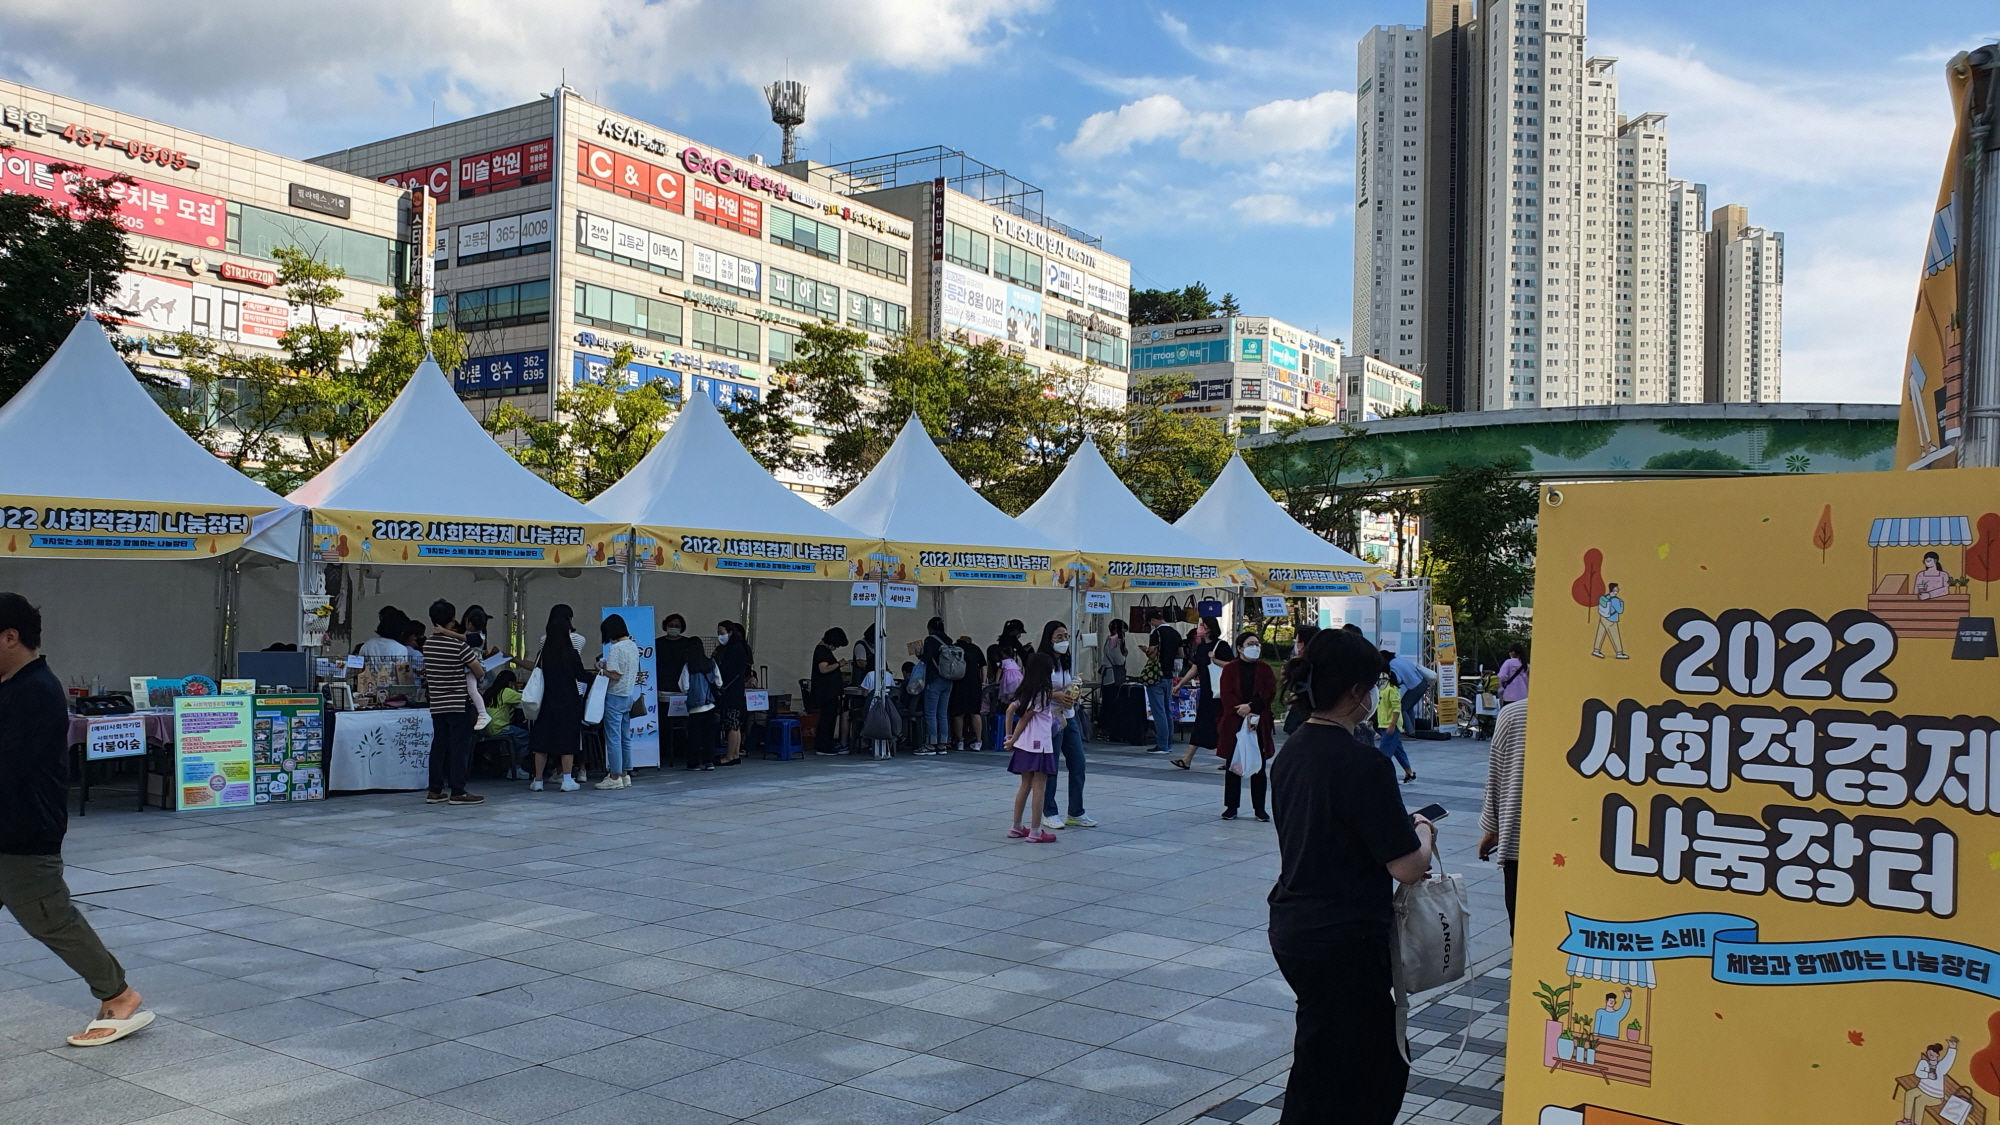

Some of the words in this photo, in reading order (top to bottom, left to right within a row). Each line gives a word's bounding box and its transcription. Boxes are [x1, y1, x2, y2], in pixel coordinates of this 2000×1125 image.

[0, 104, 47, 134] 학원
[62, 122, 187, 169] 437-0505
[462, 151, 521, 184] 미술학원
[590, 150, 613, 179] C
[656, 172, 678, 199] C
[737, 168, 789, 200] 미술학원
[177, 197, 217, 226] 모집
[695, 187, 739, 218] 미술학원
[463, 231, 489, 248] 고등관
[496, 219, 548, 244] 365-4009
[591, 225, 610, 242] 정상
[617, 232, 645, 252] 고등관
[224, 264, 275, 285] STRIKEZON
[1060, 270, 1082, 295] 패스
[775, 274, 834, 308] 피아노
[852, 296, 883, 323] 보컬
[945, 282, 966, 305] 등관
[968, 290, 984, 310] 8월
[986, 296, 1004, 316] 이전
[523, 354, 545, 367] 362-
[1152, 351, 1176, 361] ETOOS
[1189, 349, 1201, 358] 학원
[523, 367, 545, 381] 6395
[44, 508, 159, 534] 사회적경제
[164, 511, 249, 536] 나눔장터
[374, 521, 425, 542] 2022
[429, 522, 516, 545] 사회적경제
[519, 526, 585, 546] 나눔장터
[40, 537, 74, 547] 가치있는
[96, 539, 121, 548] 체험과
[123, 540, 156, 548] 함께하는
[157, 541, 188, 549] 나눔장터
[514, 550, 538, 558] 나눔장터
[682, 536, 722, 555] 2022
[725, 538, 794, 559] 사회적경제
[796, 543, 848, 561] 나눔장터
[921, 552, 954, 568] 2022
[955, 553, 1009, 569] 사회적경제
[1010, 555, 1051, 570] 나눔장터
[1109, 562, 1135, 576] 2022
[1136, 562, 1183, 578] 사회적경제
[1184, 564, 1220, 579] 나눔장터
[1269, 569, 1295, 581] 2022
[1667, 613, 1897, 701] 2022
[91, 721, 141, 732] (예비)사회적기업
[97, 732, 136, 741] 사회적협동조합
[92, 738, 141, 753] 더불어숲
[1576, 706, 2000, 815] 사회적경제
[1609, 801, 1957, 917] 나눔장터
[1438, 912, 1452, 973] KANGOL
[1578, 928, 1655, 952] 가치있는
[1660, 927, 1706, 951] 소비!
[1726, 951, 1792, 977] 체험과
[1795, 949, 1887, 976] 함께하는
[1892, 949, 1990, 984] 나눔장터
